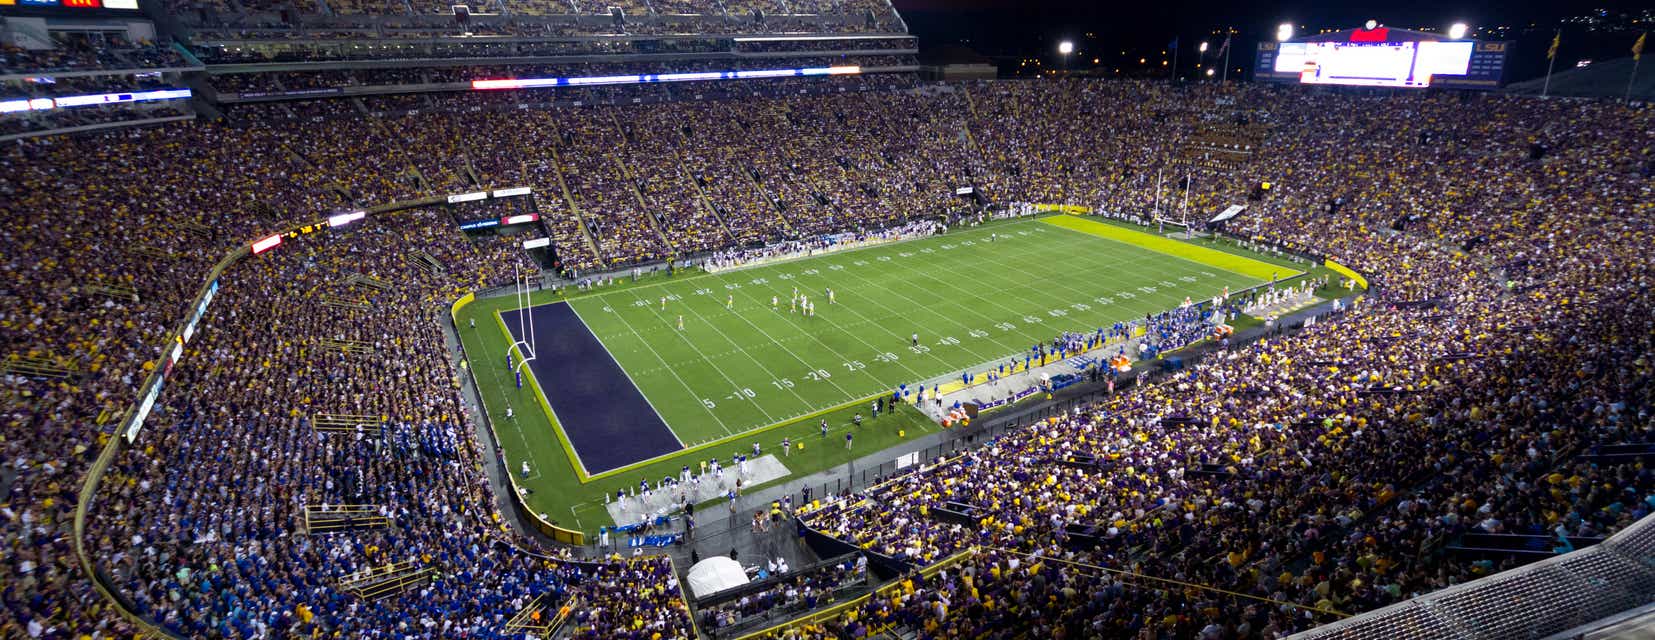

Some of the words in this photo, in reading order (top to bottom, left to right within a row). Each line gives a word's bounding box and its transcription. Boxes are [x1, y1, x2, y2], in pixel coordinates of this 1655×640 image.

[1476, 43, 1505, 52] LSU
[939, 336, 961, 345] 40
[880, 352, 899, 362] 30
[842, 360, 866, 371] 25
[808, 369, 832, 381] 20
[771, 378, 795, 390] 15
[733, 387, 756, 401] 10
[702, 398, 716, 409] 5
